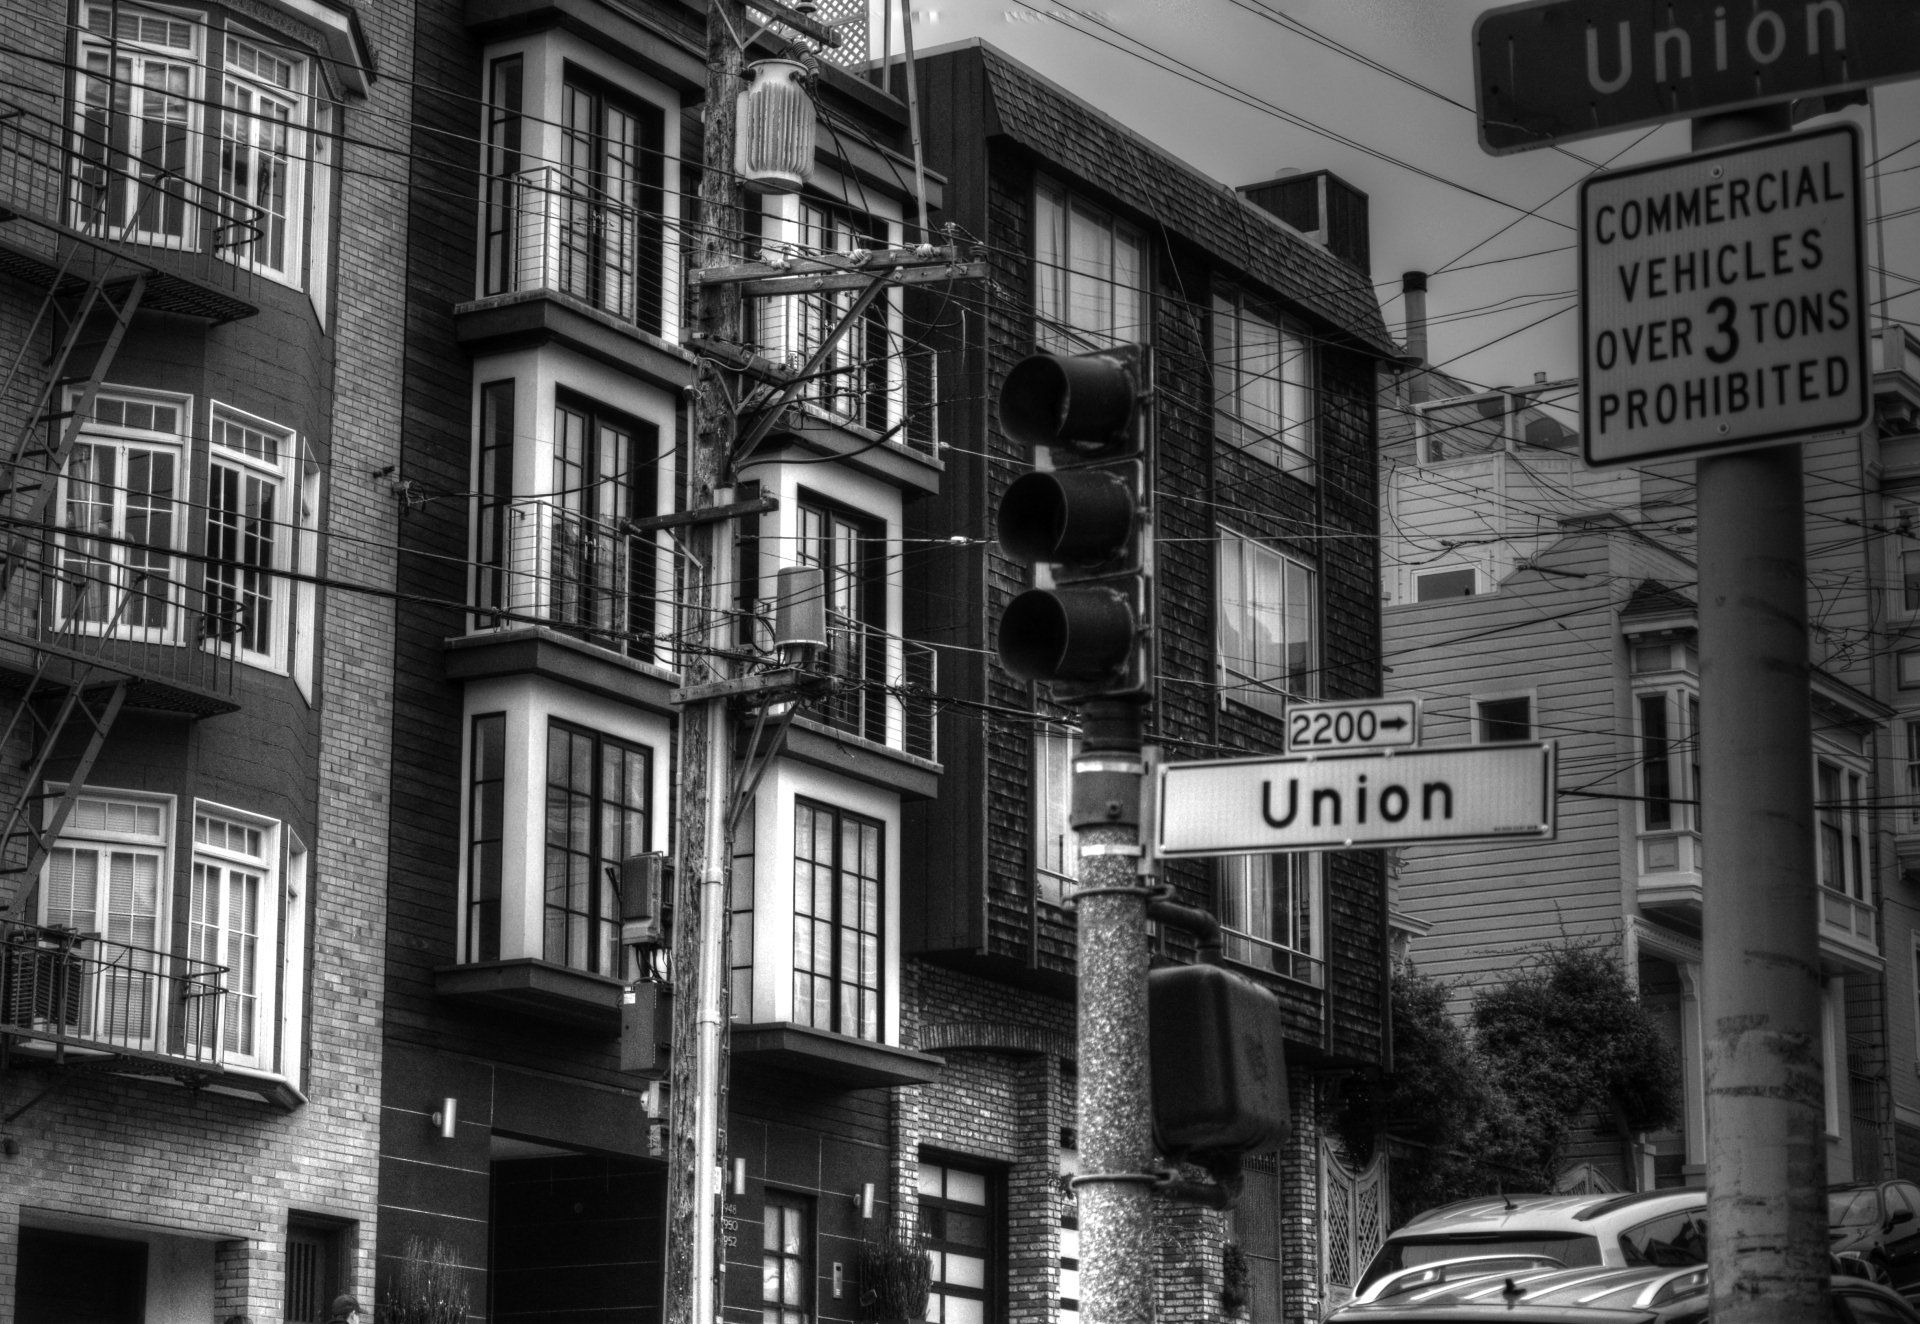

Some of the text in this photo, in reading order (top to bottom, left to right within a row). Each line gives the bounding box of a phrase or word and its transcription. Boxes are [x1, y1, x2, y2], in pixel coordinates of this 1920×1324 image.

[1586, 0, 1845, 93] Union
[1597, 162, 1844, 244] COMMERCIAL
[1619, 229, 1823, 303] VEHICLES
[1596, 289, 1850, 370] OVER 3 TONS
[1600, 356, 1850, 434] PROHIBITED
[1293, 710, 1377, 745] 2200
[1262, 774, 1453, 828] Union
